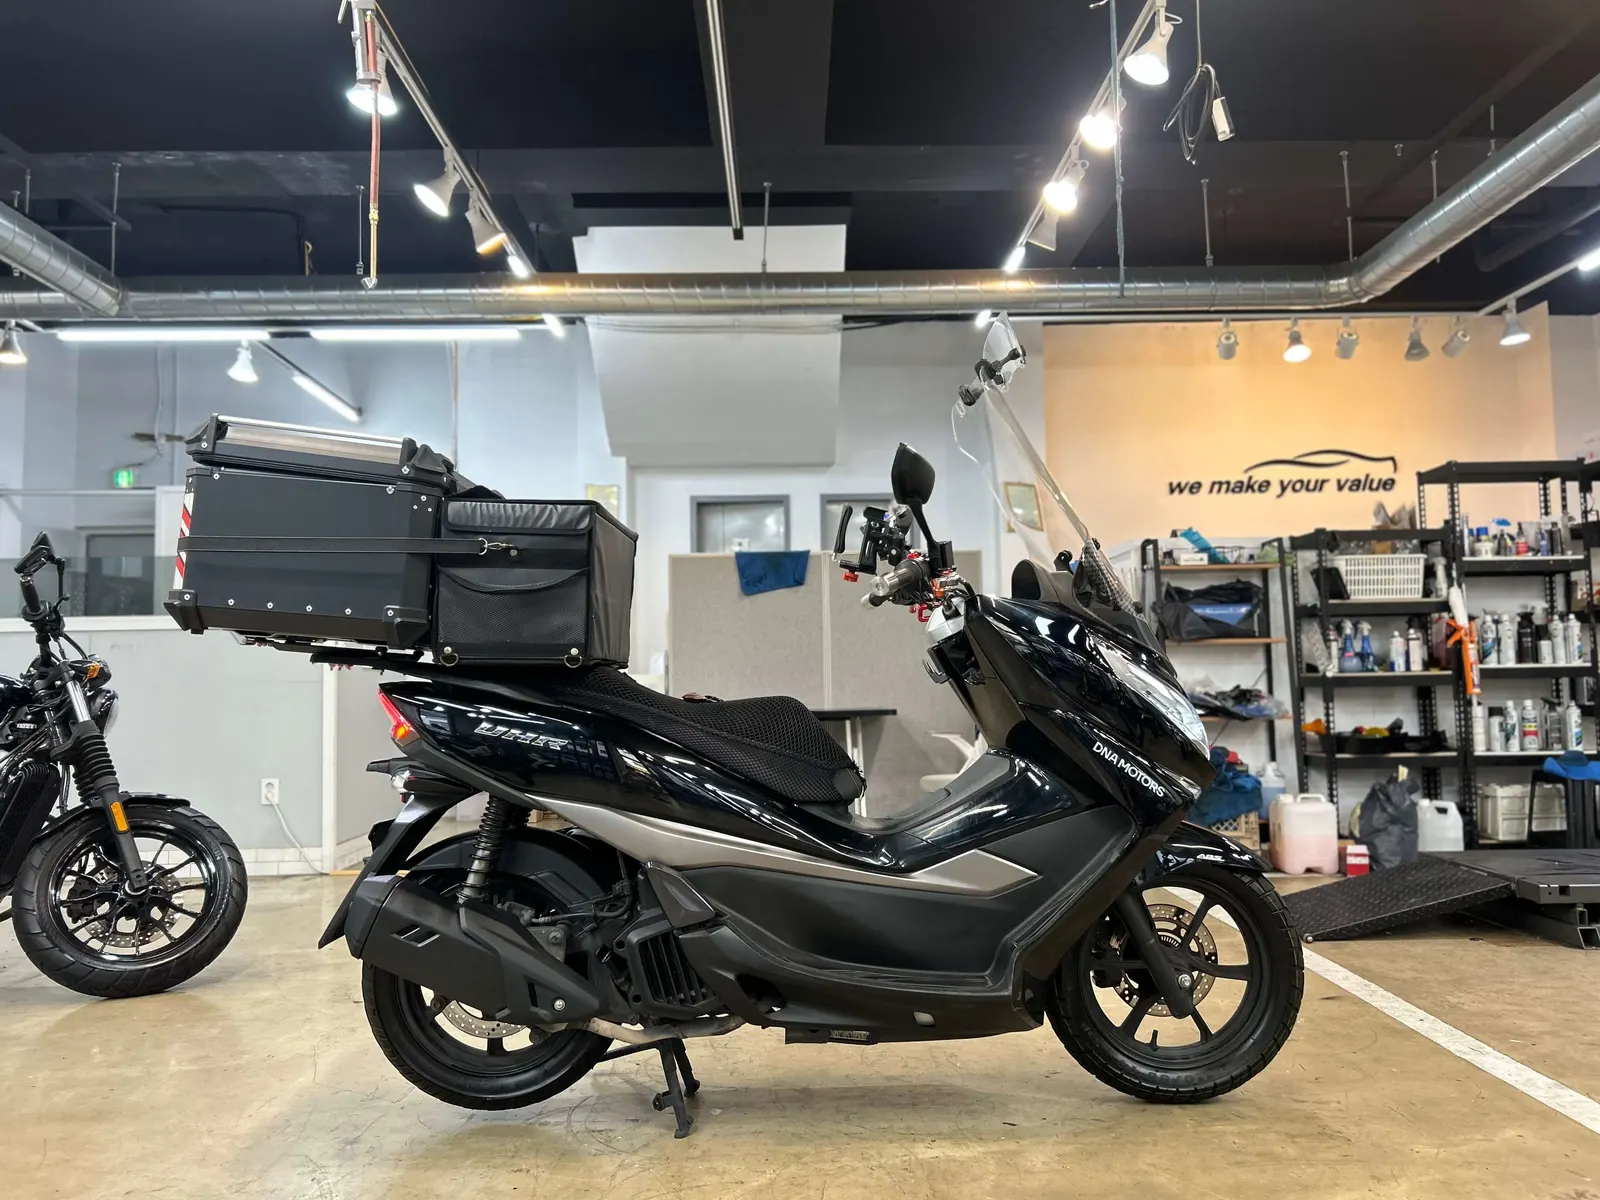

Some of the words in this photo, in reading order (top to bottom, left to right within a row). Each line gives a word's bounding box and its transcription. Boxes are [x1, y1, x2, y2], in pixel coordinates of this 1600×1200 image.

[1168, 480, 1202, 495] we
[1208, 476, 1271, 495] make
[1276, 478, 1330, 499] your
[1336, 474, 1396, 493] value
[1092, 741, 1119, 765] DNA
[1117, 758, 1165, 797] MOTORS
